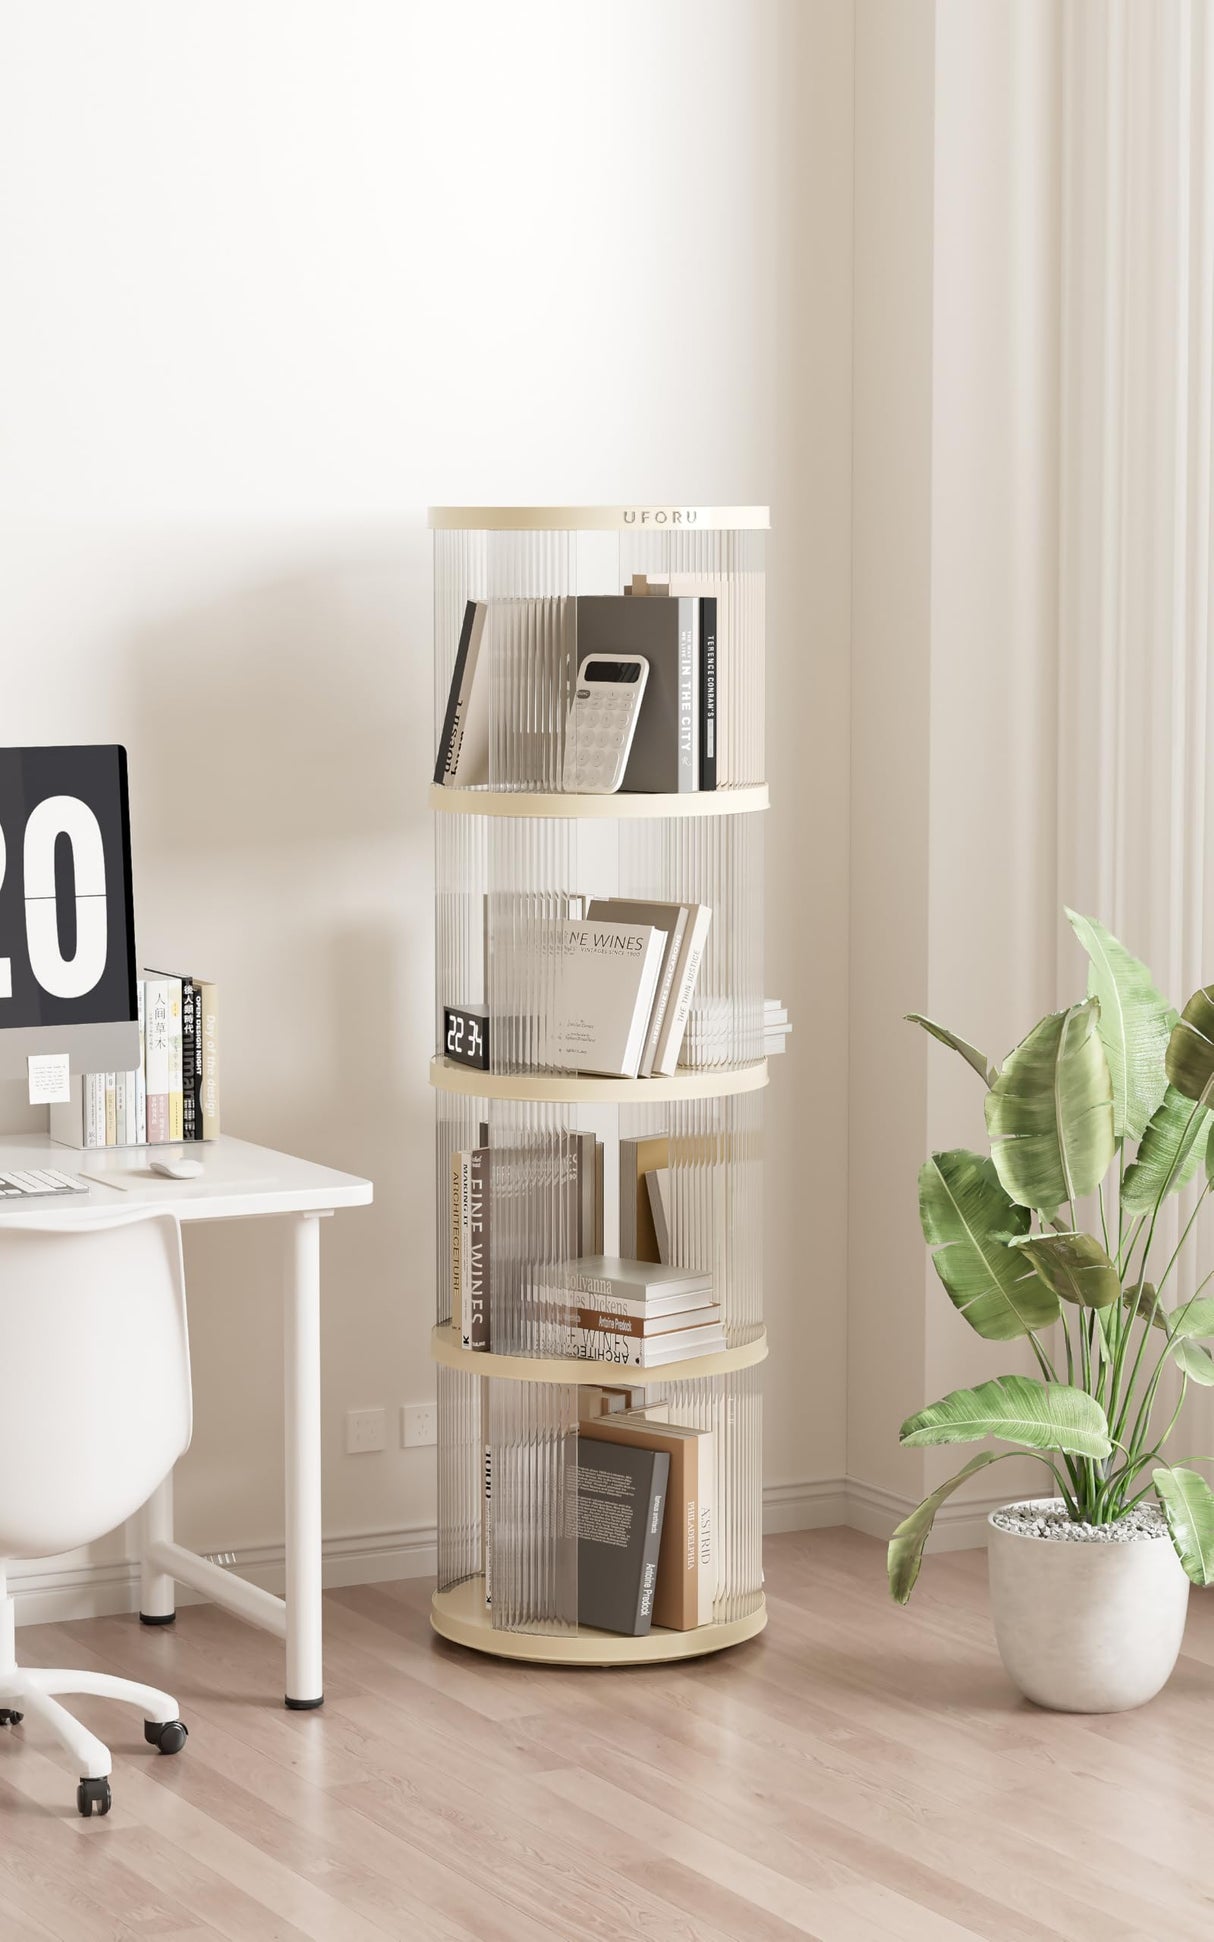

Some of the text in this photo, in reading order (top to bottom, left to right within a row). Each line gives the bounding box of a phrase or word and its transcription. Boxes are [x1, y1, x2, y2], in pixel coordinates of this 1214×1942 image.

[623, 510, 698, 524] UFORU
[707, 635, 715, 675] TERENCE
[681, 660, 691, 751] IN THE CITY
[707, 677, 715, 717] CONRAN'S
[593, 933, 643, 951] WINES
[183, 985, 195, 1034] 後人類時代
[677, 1005, 687, 1023] THE
[687, 948, 701, 983] JUSTICE
[153, 992, 167, 1050] 人间草木
[205, 1014, 216, 1118] Day of the design
[570, 1274, 612, 1296] ollyanna
[687, 1501, 695, 1570] PHILADELPHIA
[699, 1507, 712, 1567] ASTRID
[640, 1563, 656, 1616] Antoine Predock
